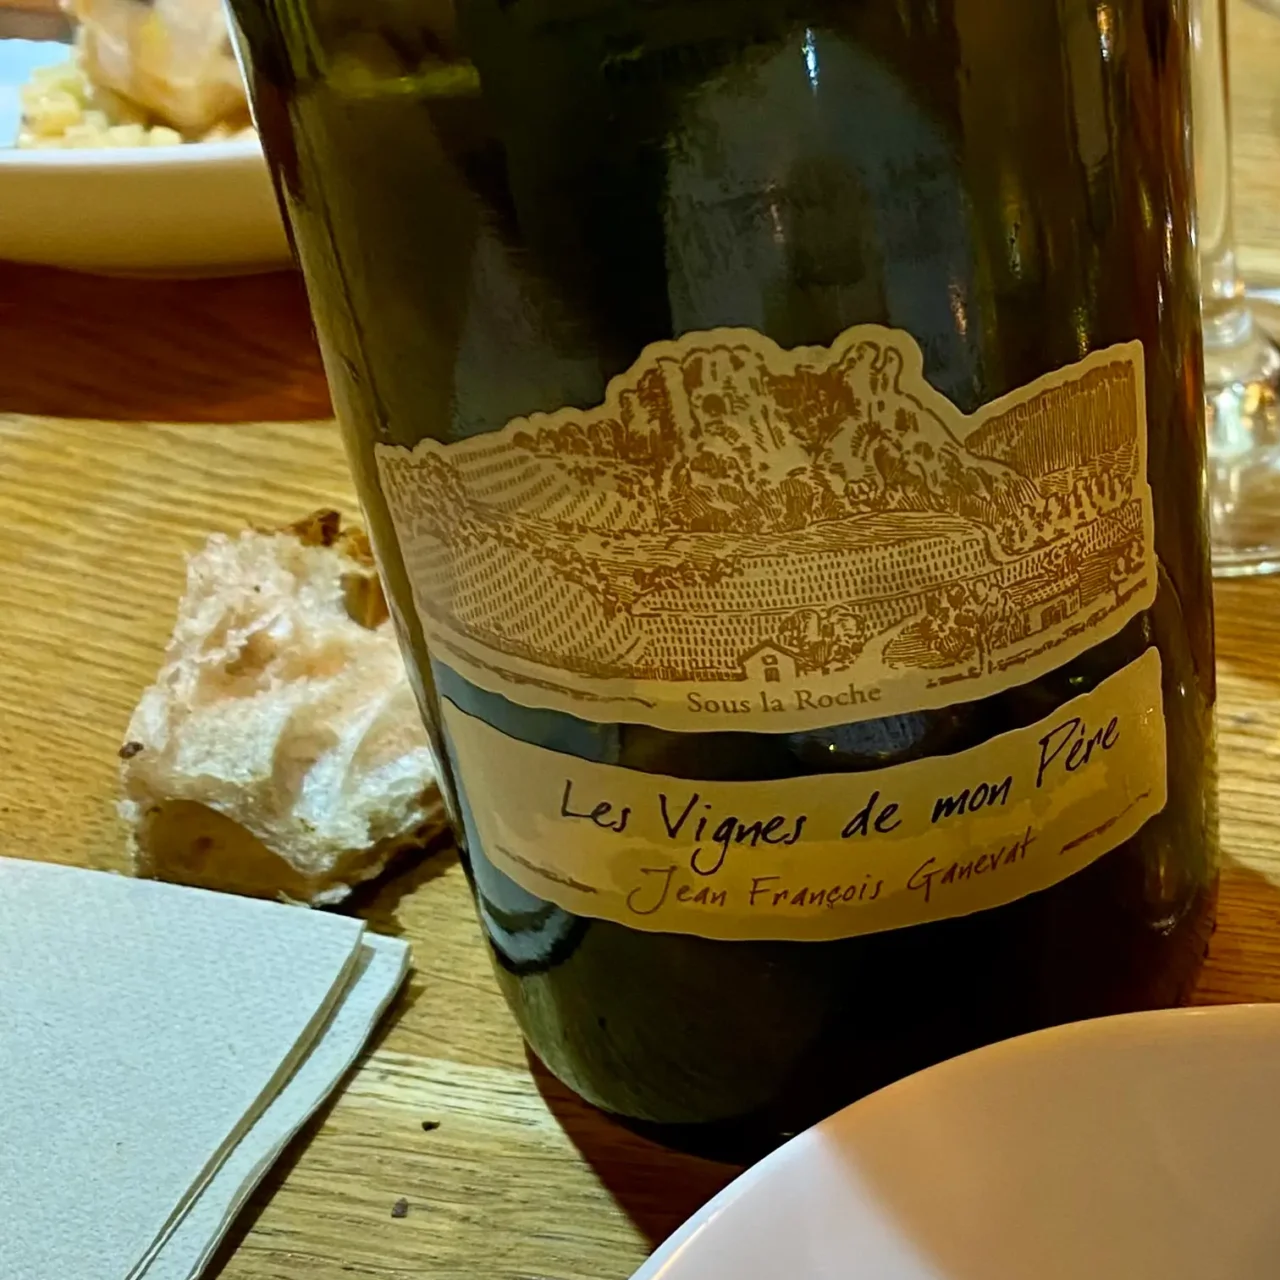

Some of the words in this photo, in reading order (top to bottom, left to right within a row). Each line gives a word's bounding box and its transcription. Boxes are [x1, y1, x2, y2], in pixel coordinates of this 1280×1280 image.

[686, 691, 750, 714] Sous
[759, 690, 785, 713] la
[795, 683, 882, 711] Roche
[560, 779, 631, 833] Les
[658, 792, 807, 876] Vignes
[841, 791, 901, 838] de
[931, 776, 1012, 823] mon
[626, 865, 727, 915] Jean
[749, 874, 884, 909] François
[907, 826, 1037, 903] Ganevat
